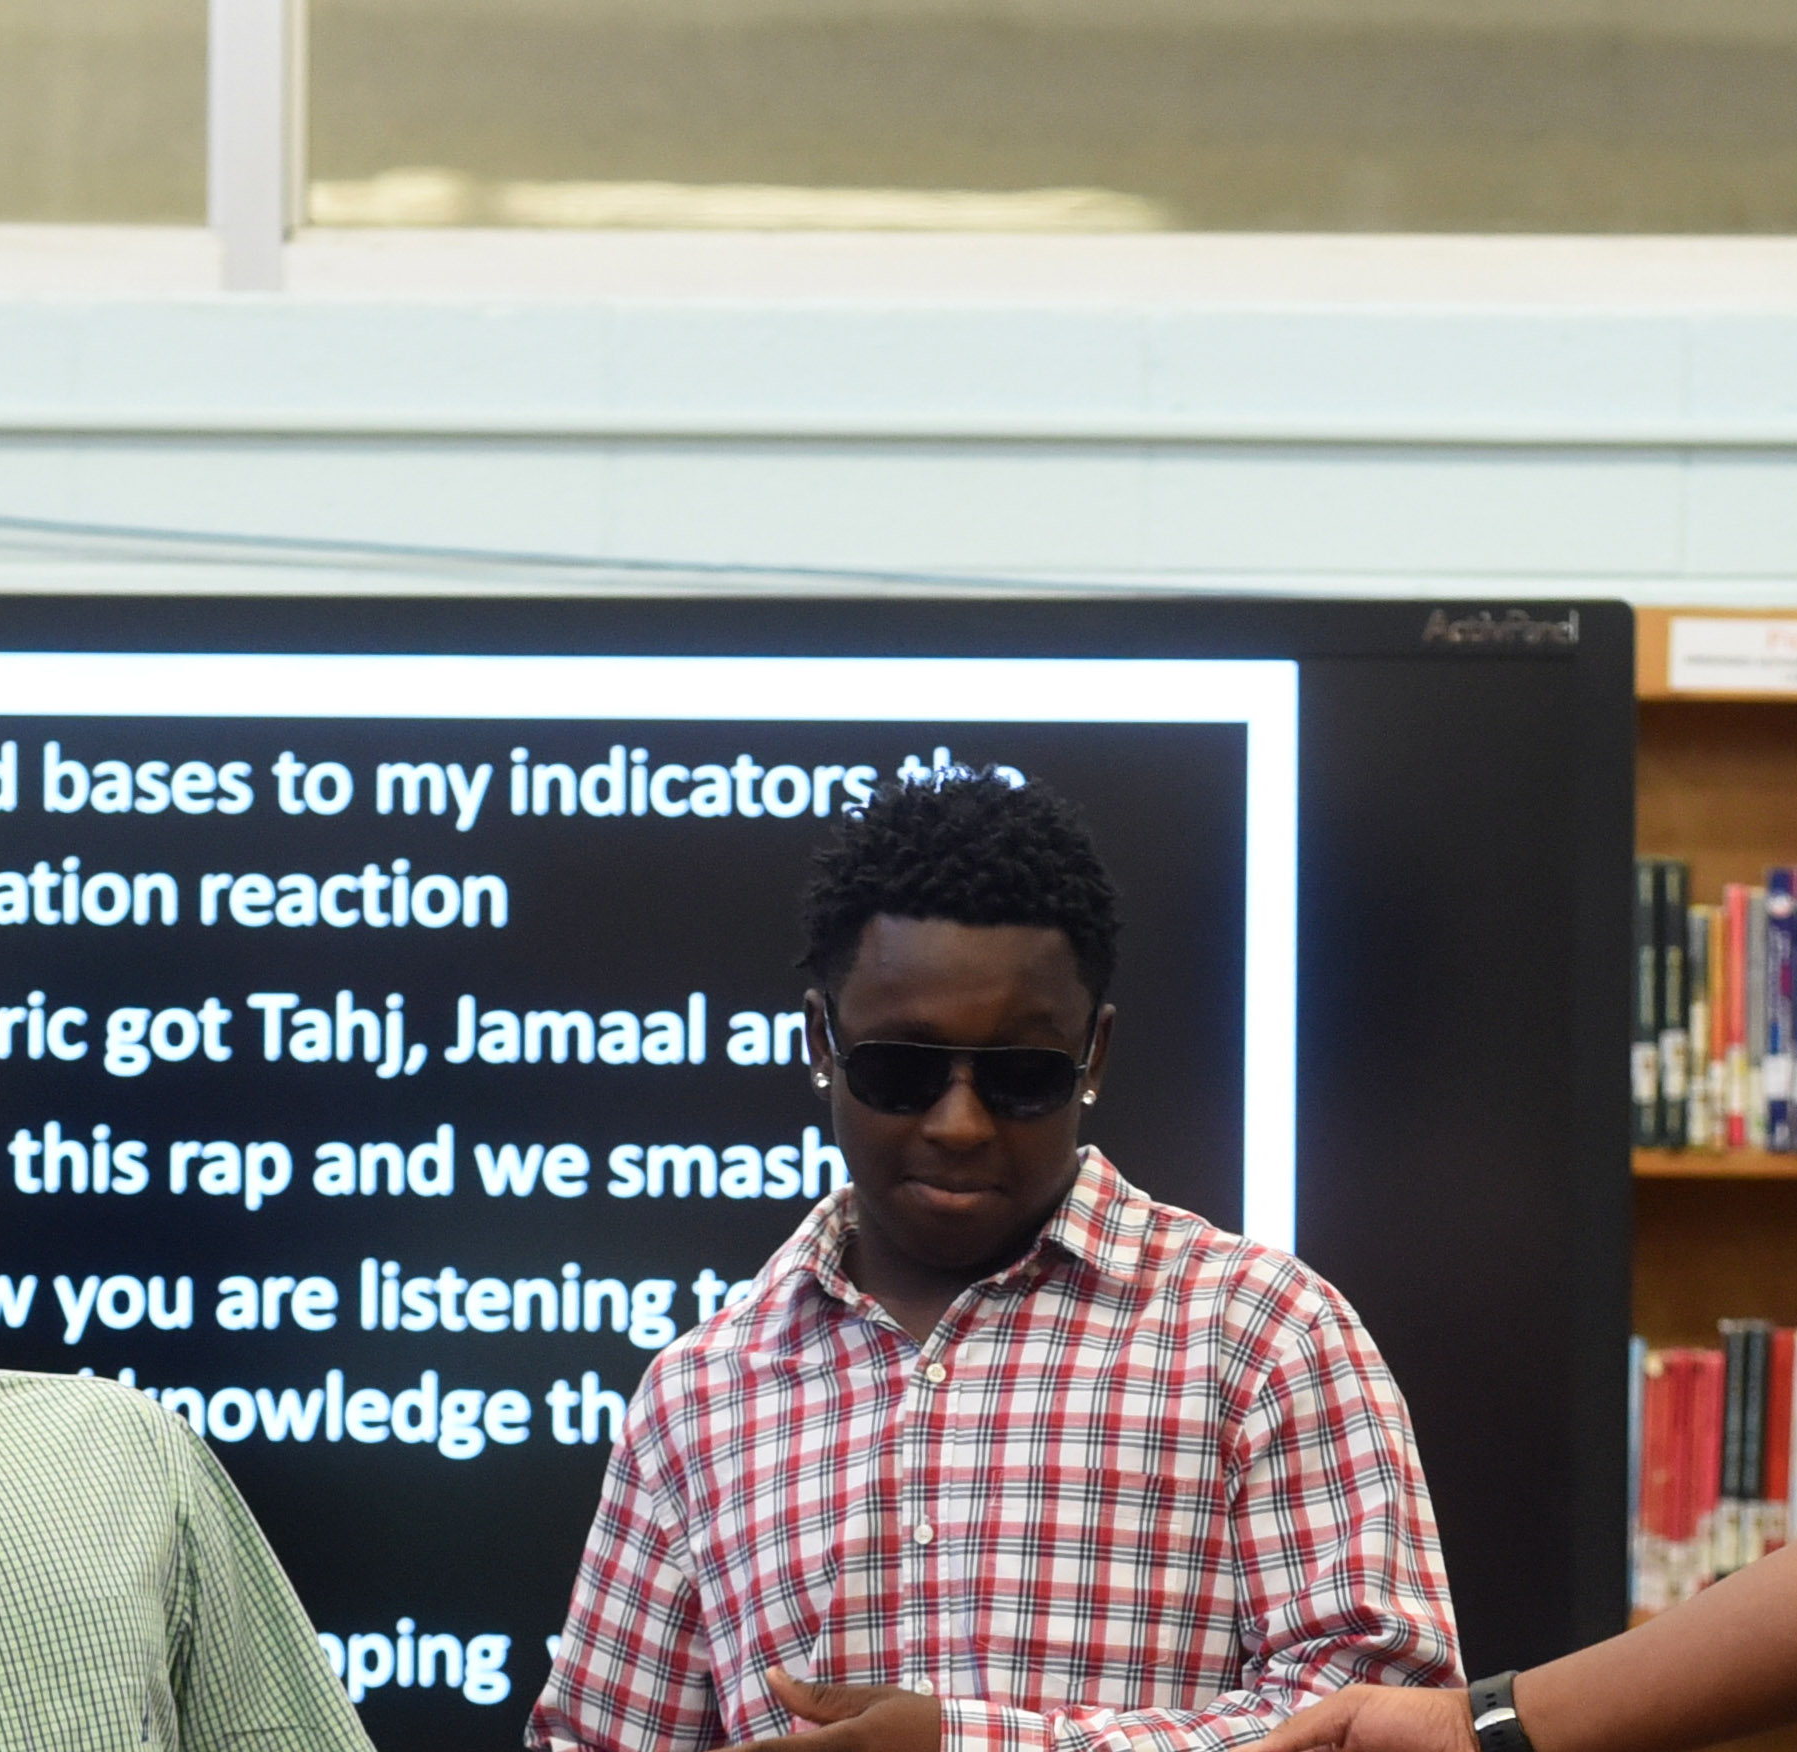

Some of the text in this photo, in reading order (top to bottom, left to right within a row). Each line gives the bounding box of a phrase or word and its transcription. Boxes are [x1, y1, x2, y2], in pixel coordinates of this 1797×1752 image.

[43, 740, 254, 815] bases
[271, 750, 354, 816] to
[375, 761, 493, 833] my
[509, 744, 879, 821] indicators
[199, 857, 509, 929] reaction
[104, 996, 233, 1079] got
[246, 989, 428, 1079] Tahj,
[443, 990, 707, 1066] Jamaal
[725, 1010, 812, 1066] an
[7, 1119, 150, 1195] this
[169, 1140, 293, 1212] rap
[312, 1123, 455, 1198] and
[473, 1143, 591, 1199] we
[52, 1274, 194, 1345] you
[215, 1275, 339, 1331] are
[360, 1257, 677, 1350] listening
[544, 1370, 628, 1445] th
